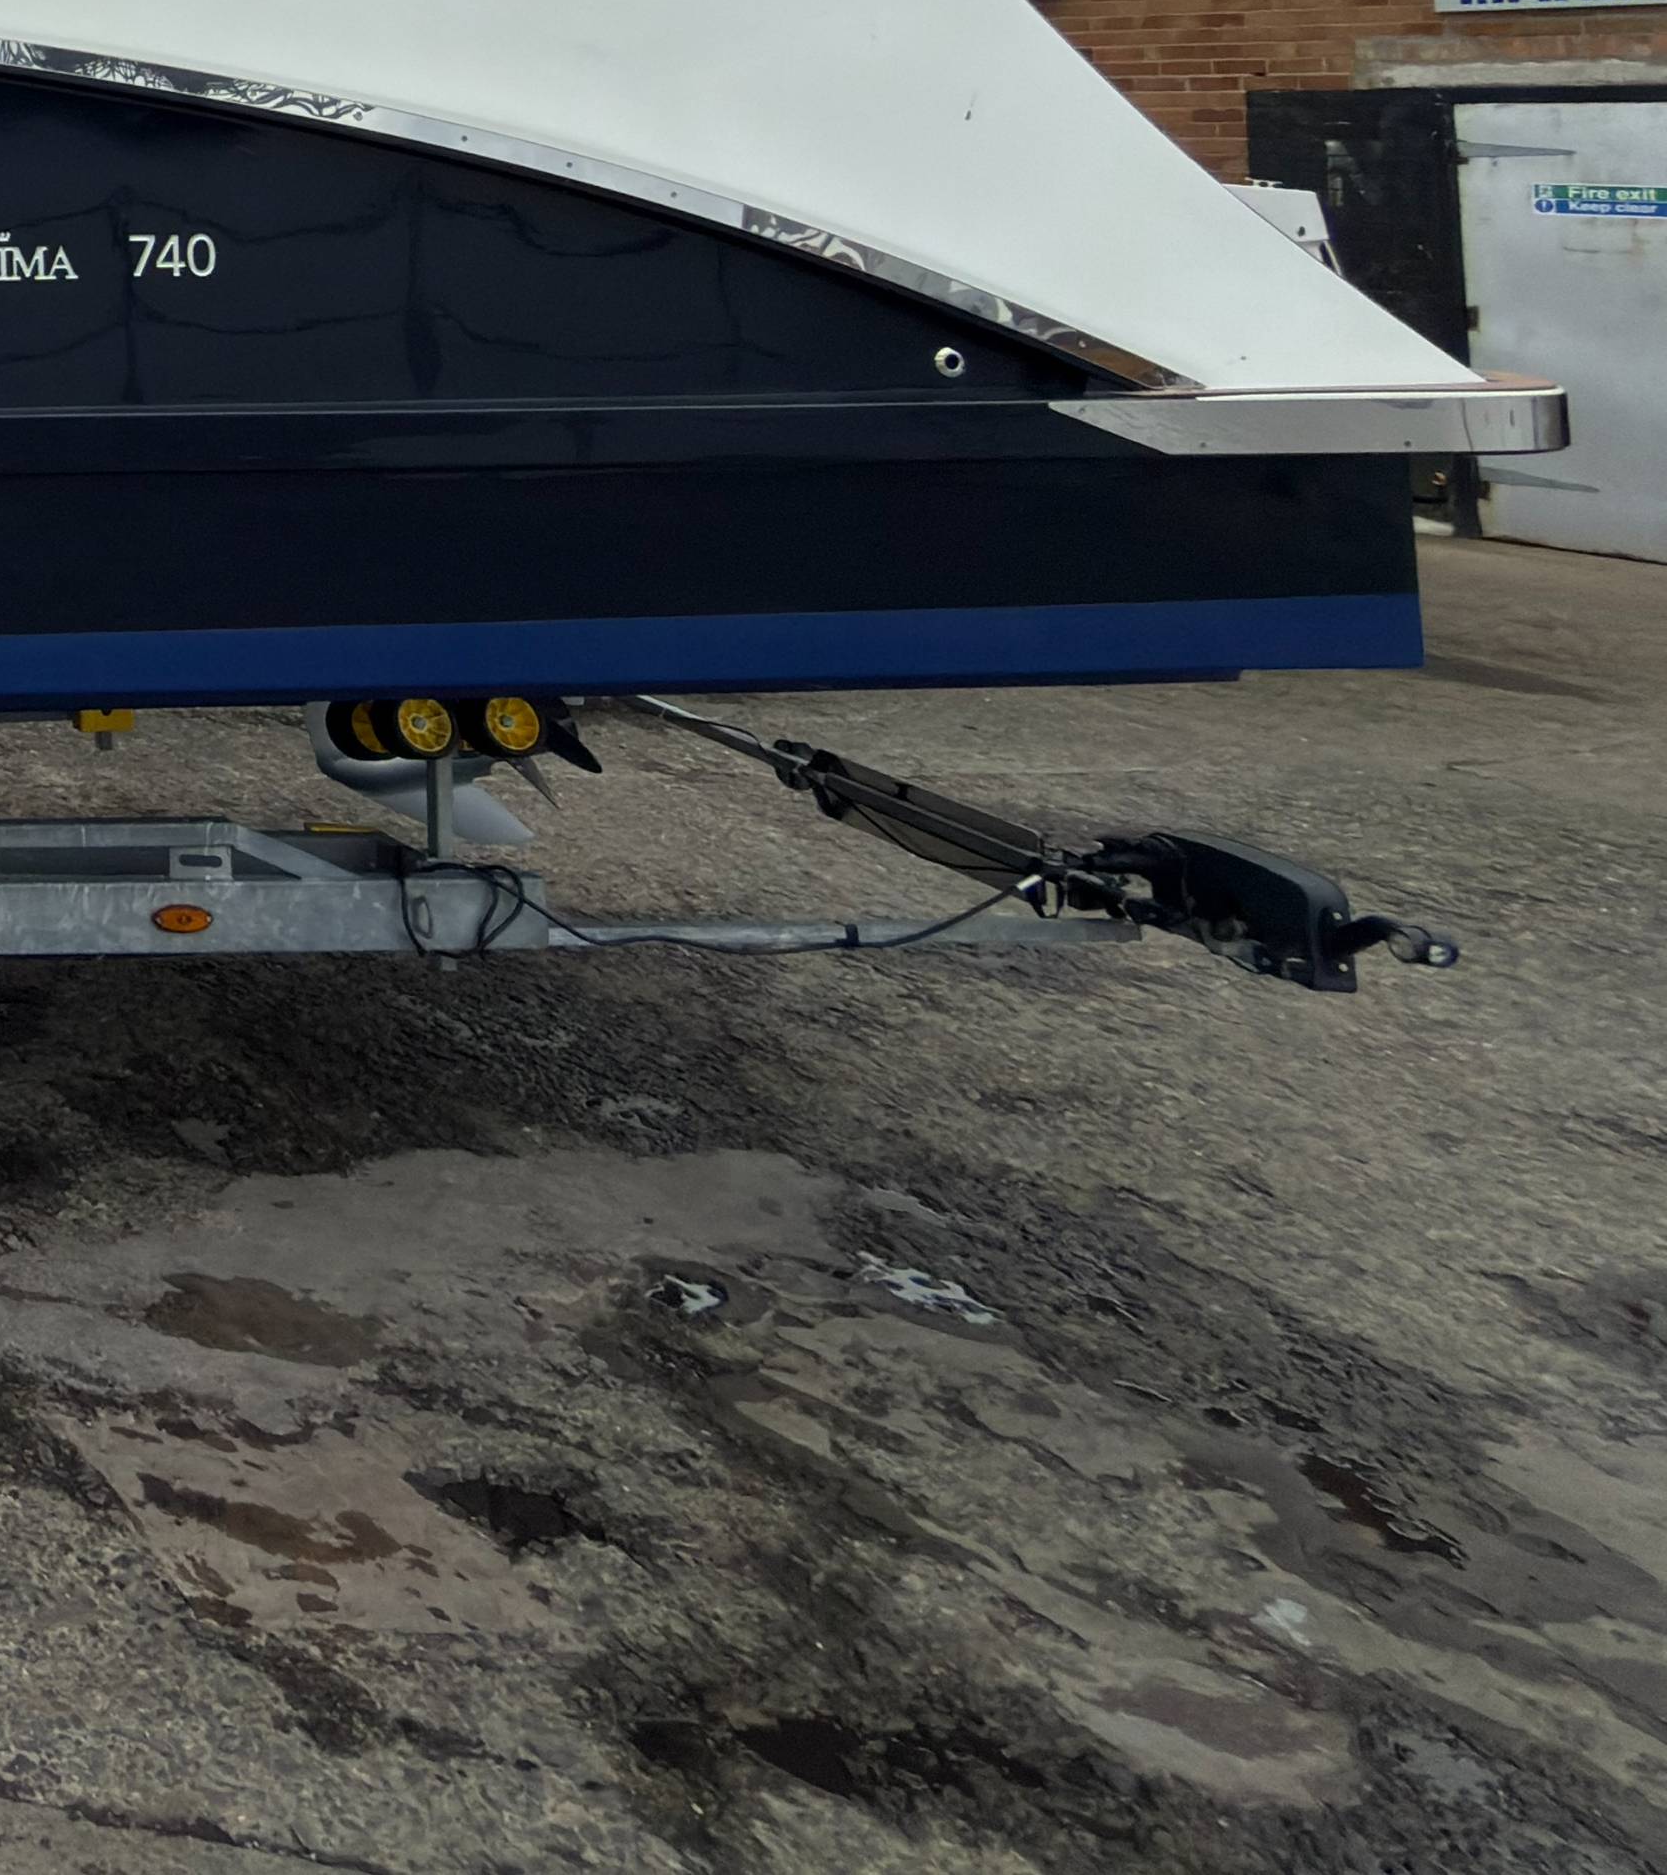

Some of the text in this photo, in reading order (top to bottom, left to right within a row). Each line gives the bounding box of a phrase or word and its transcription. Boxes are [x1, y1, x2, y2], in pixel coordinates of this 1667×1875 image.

[1568, 186, 1657, 201] Fire exit
[1568, 200, 1658, 213] Keep clear
[128, 233, 217, 277] 740
